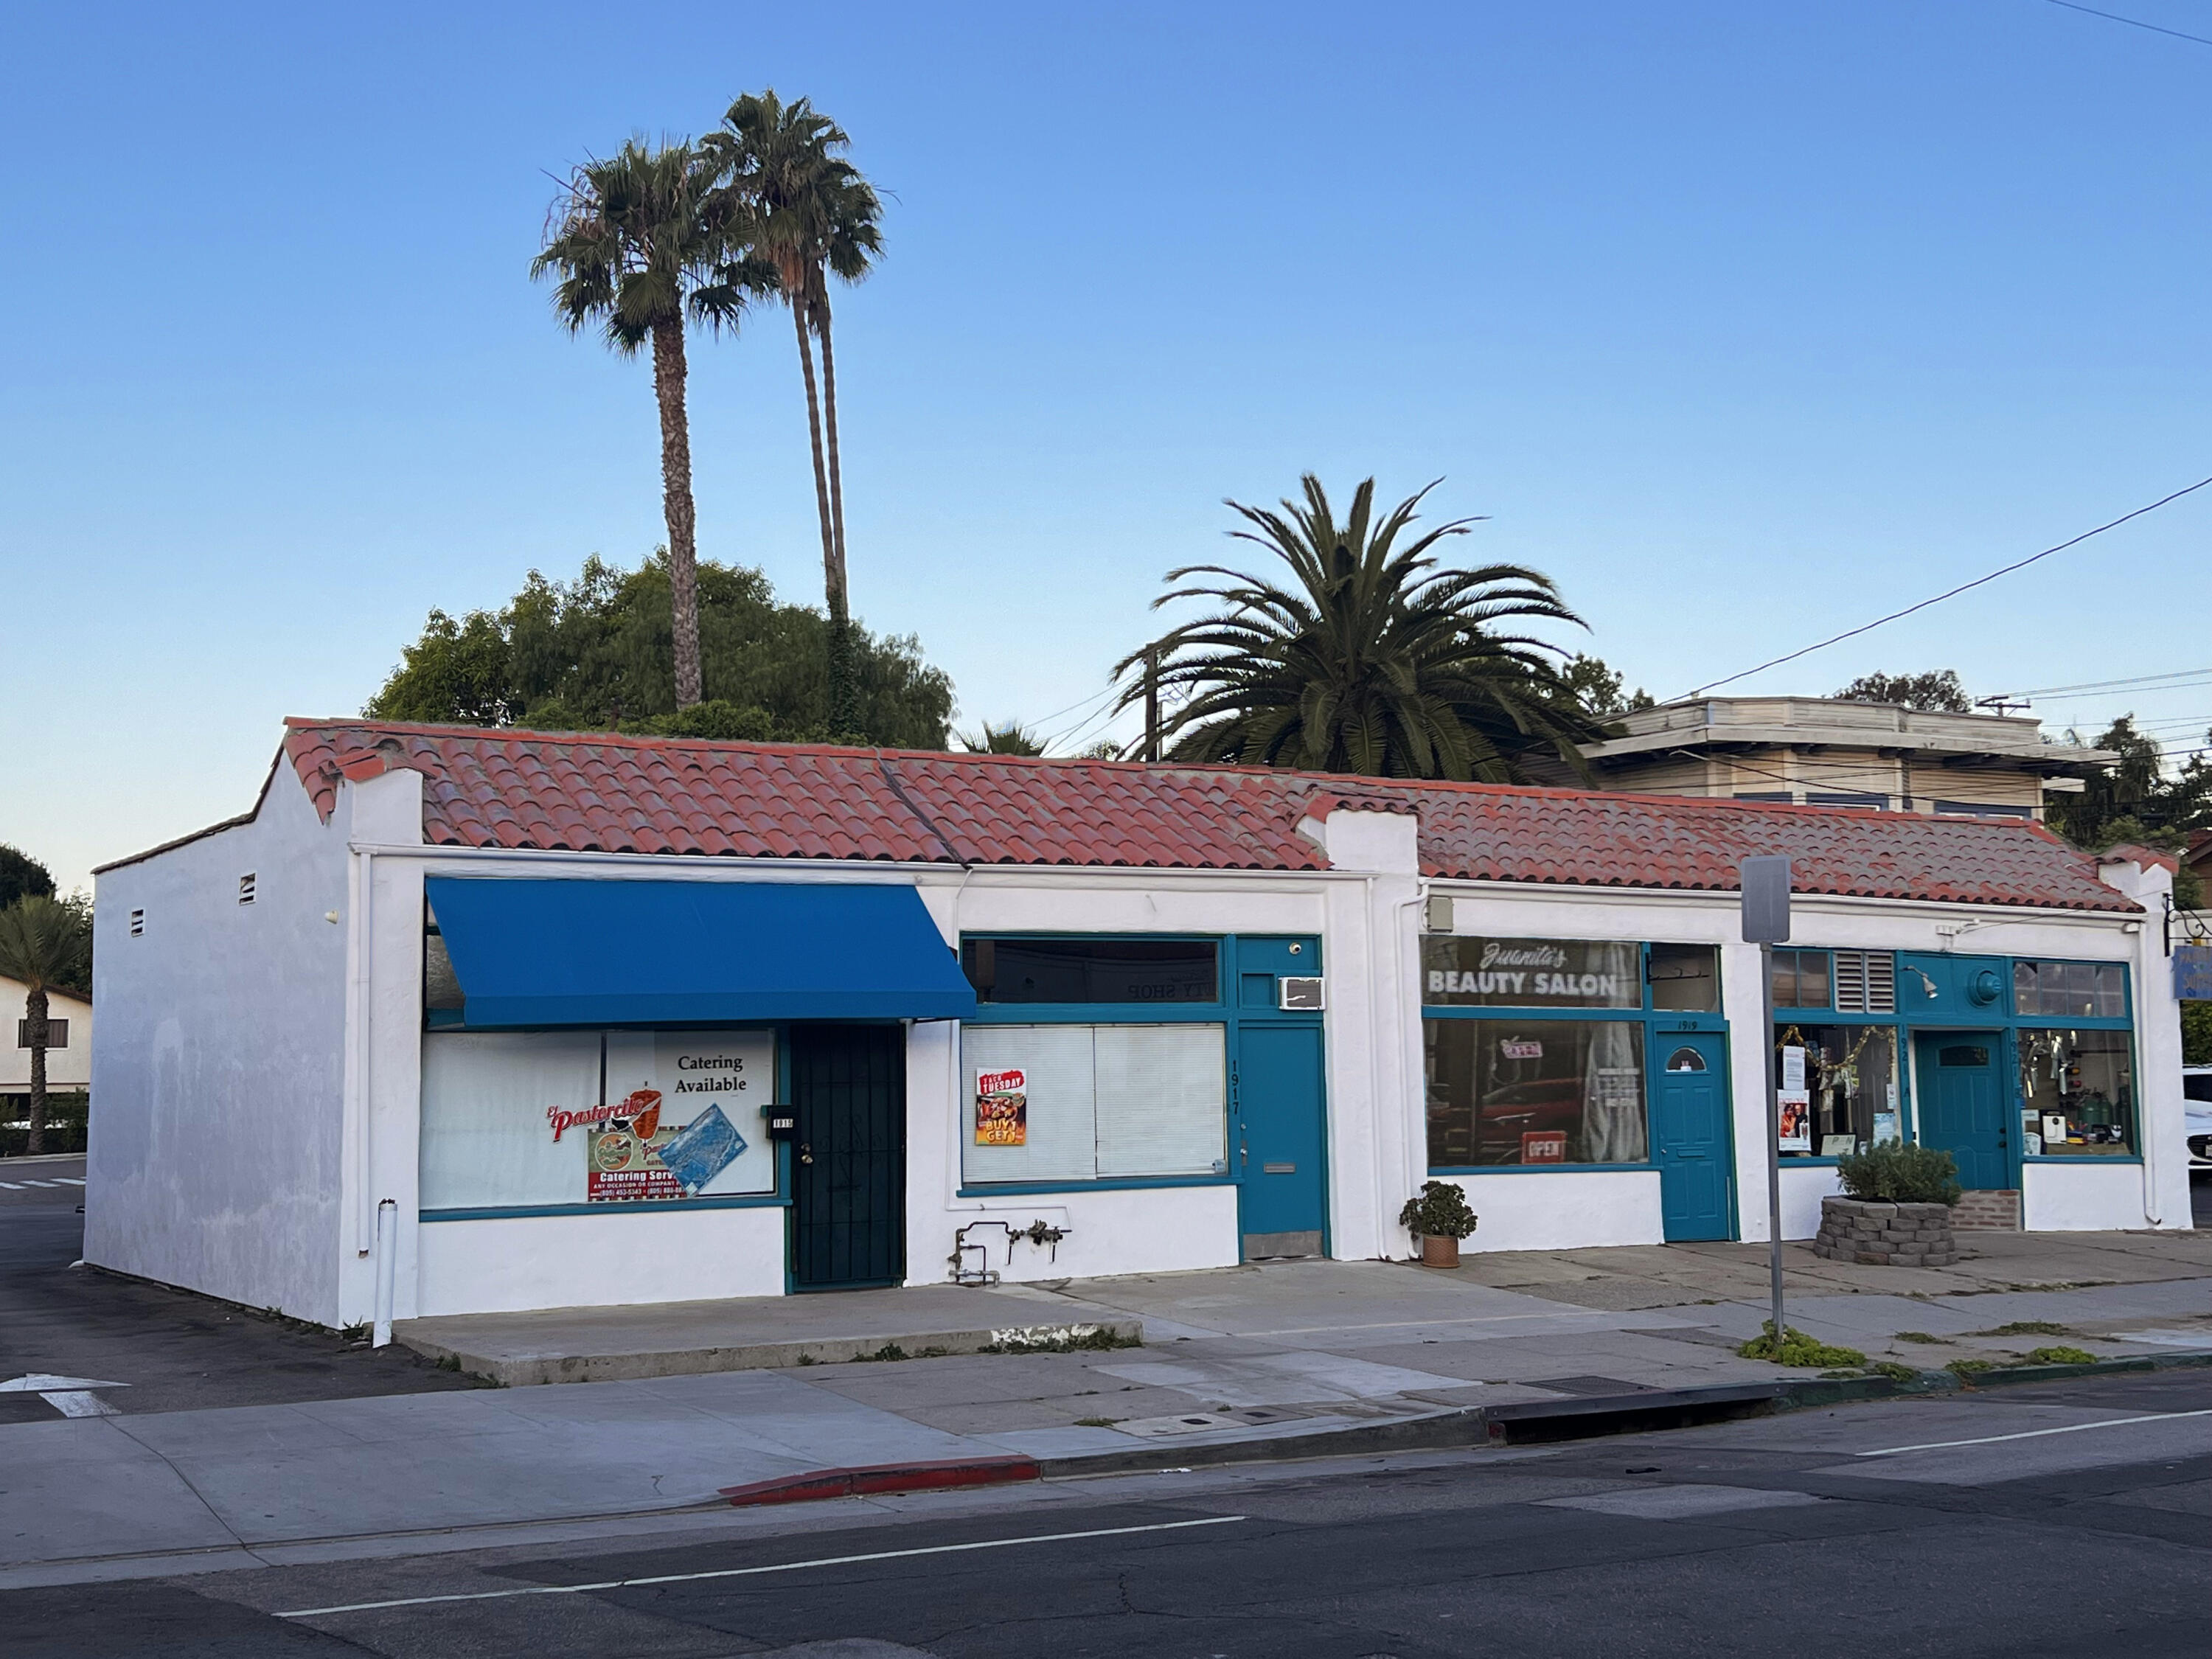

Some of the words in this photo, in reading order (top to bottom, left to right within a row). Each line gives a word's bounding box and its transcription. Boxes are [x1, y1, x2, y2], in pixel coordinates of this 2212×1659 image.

[1479, 943, 1567, 970] Juanita's
[1428, 970, 1526, 995] BEAUTY
[1534, 973, 1618, 996] SALON
[1677, 1020, 1698, 1031] 1919
[678, 1054, 743, 1073] Catering
[675, 1077, 747, 1093] Available
[983, 1077, 1022, 1093] TUESDAY
[1231, 1060, 1239, 1116] 1917
[986, 1119, 1009, 1131] BUY
[987, 1130, 1009, 1142] GET
[600, 1172, 647, 1183] Catering
[649, 1170, 675, 1180] Serv
